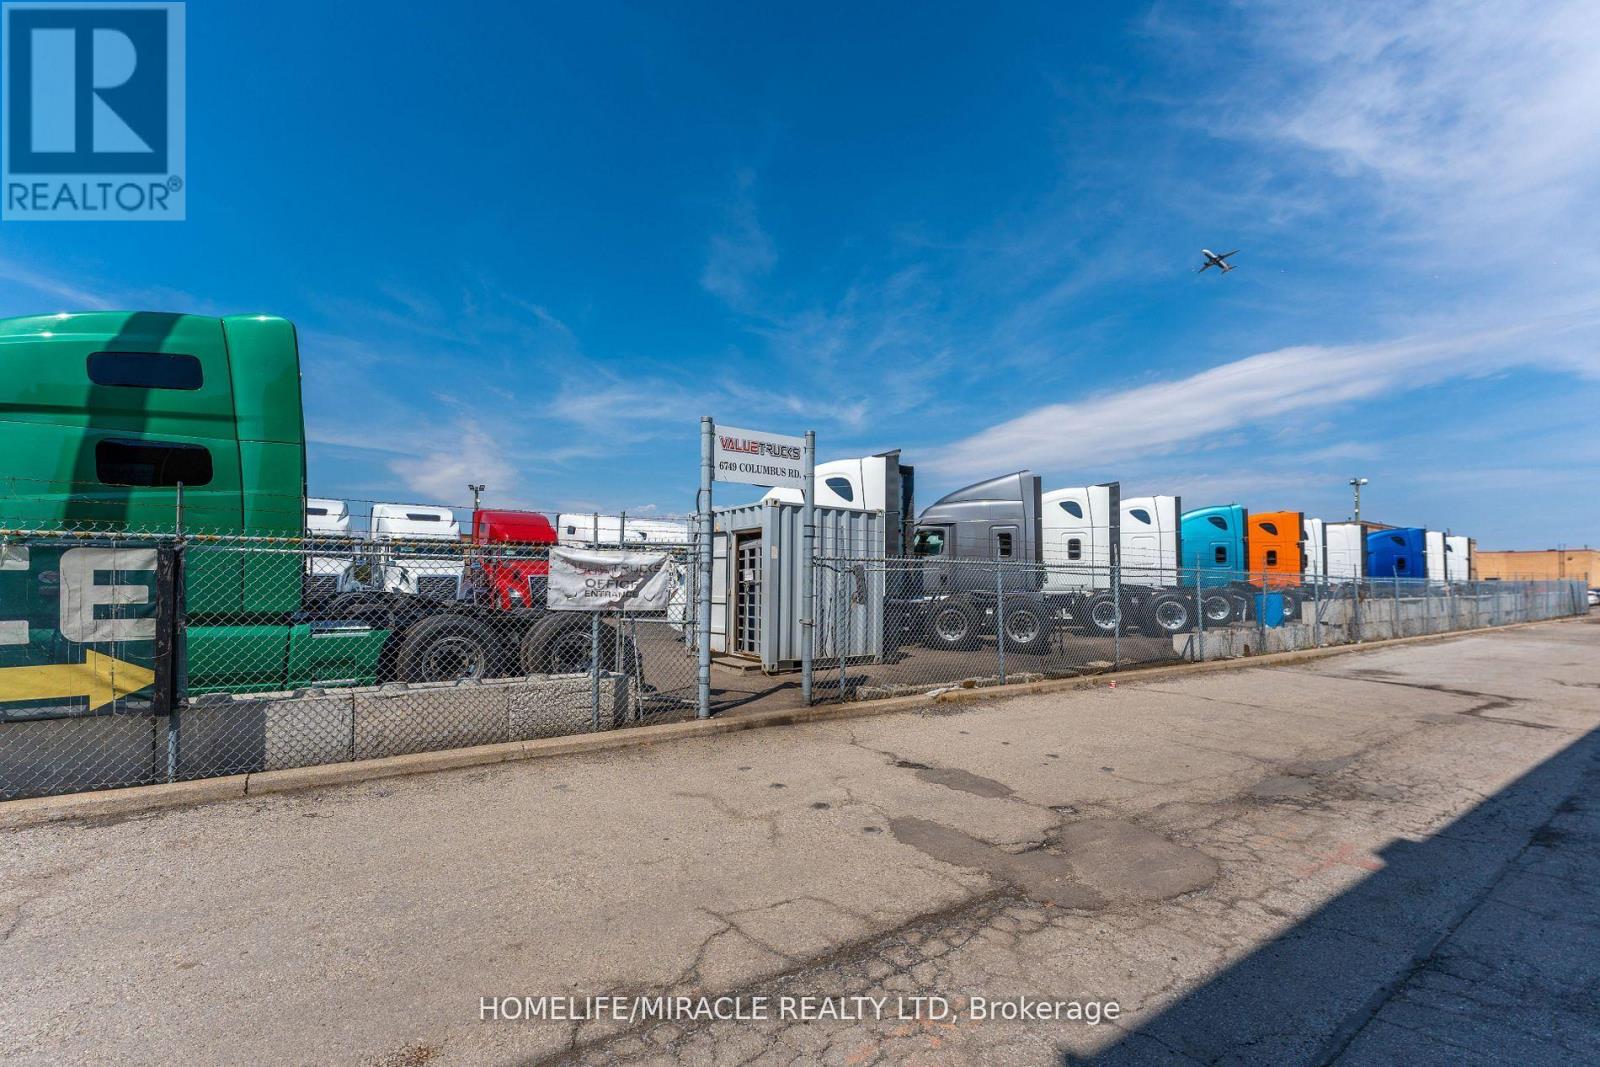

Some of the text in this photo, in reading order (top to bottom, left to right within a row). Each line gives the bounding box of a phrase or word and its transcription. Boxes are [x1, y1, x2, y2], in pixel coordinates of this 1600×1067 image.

[719, 461, 802, 479] 6749 COLUMBUS RD.
[584, 590, 640, 598] ENTRANCE
